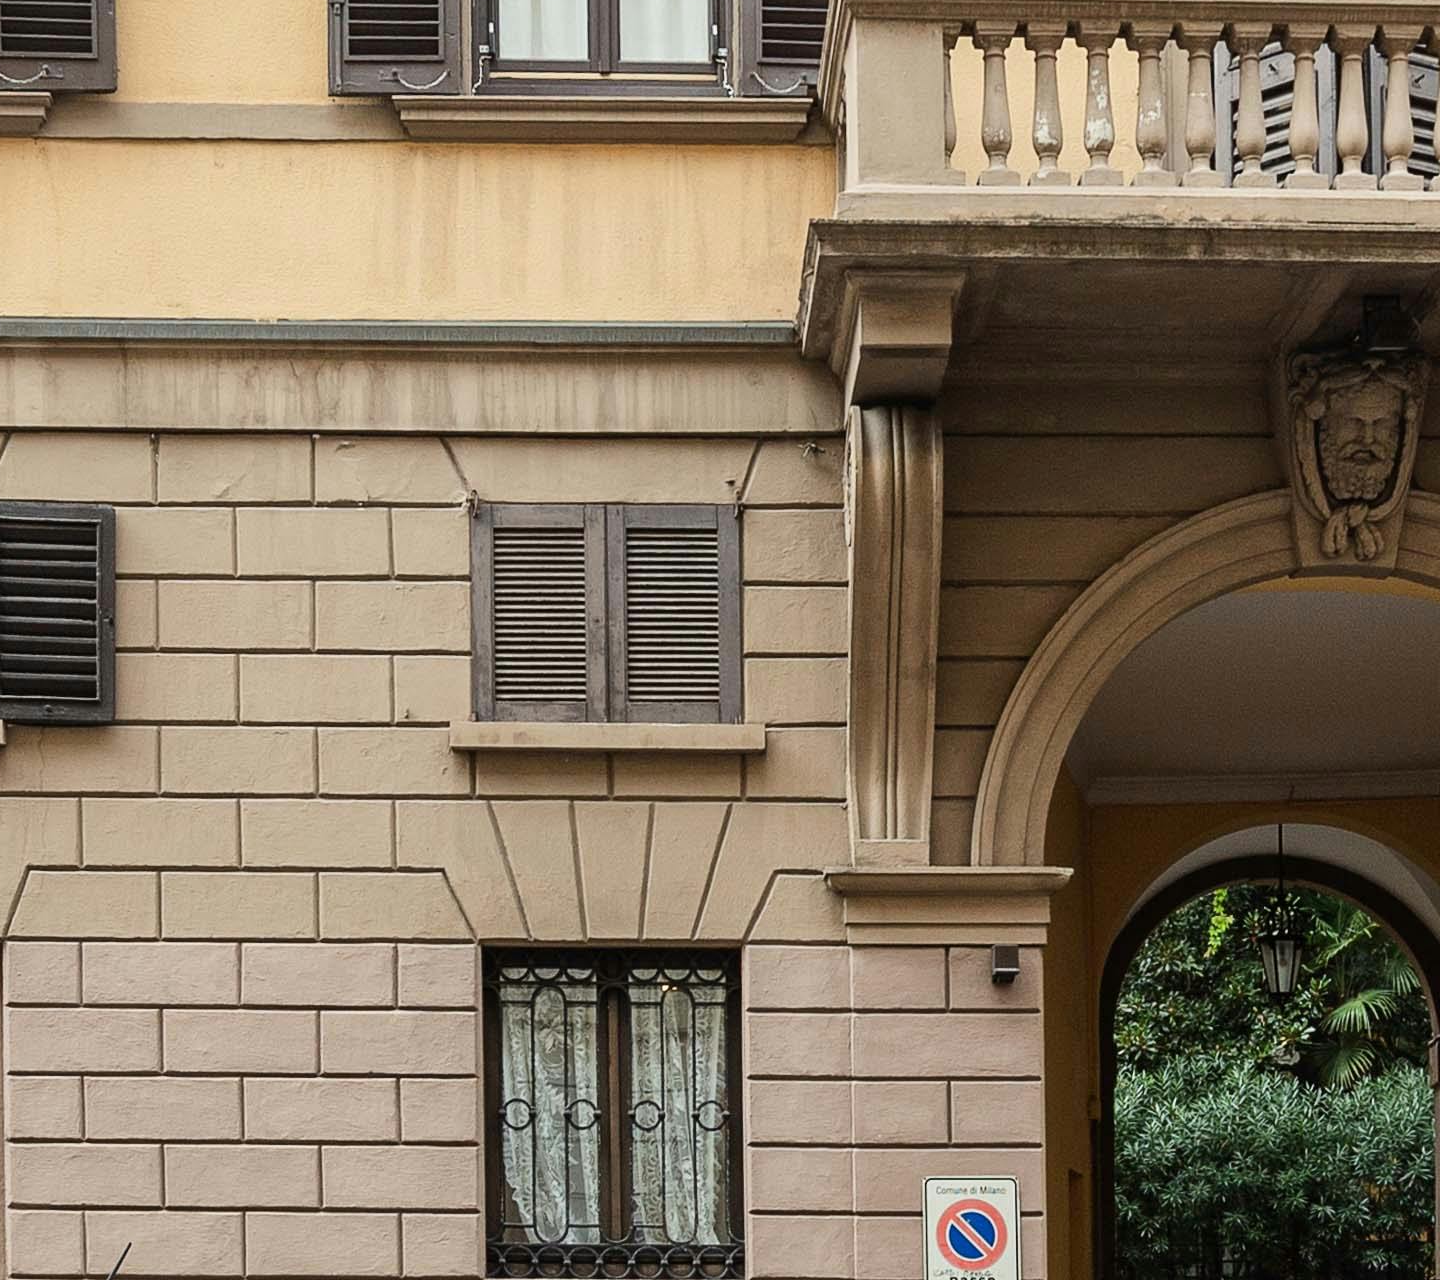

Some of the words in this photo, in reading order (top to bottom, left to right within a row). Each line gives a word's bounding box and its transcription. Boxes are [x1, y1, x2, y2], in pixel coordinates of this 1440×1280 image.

[935, 1185, 968, 1195] Comune
[969, 1185, 978, 1195] di
[979, 1185, 1008, 1195] Milano
